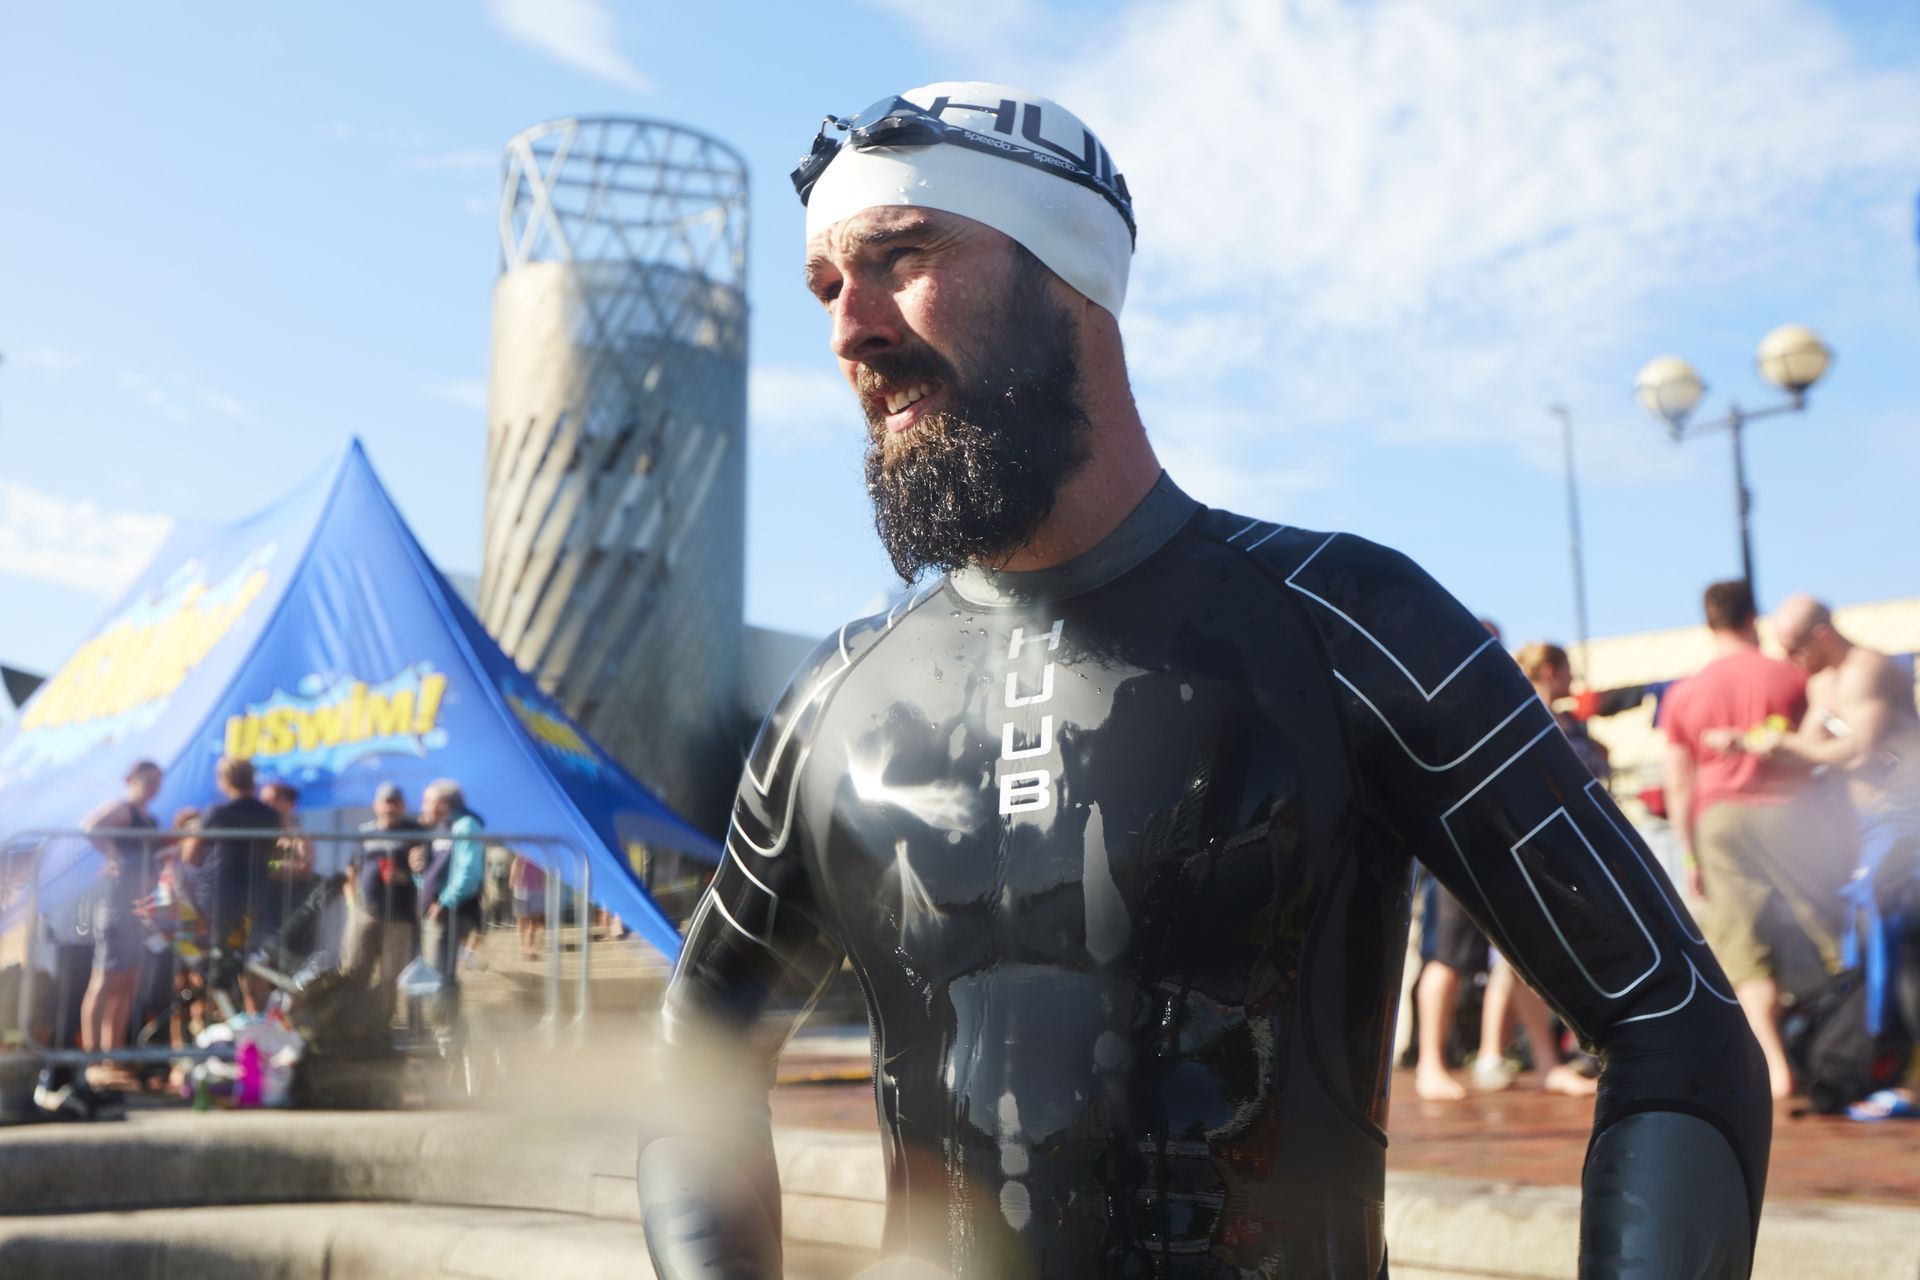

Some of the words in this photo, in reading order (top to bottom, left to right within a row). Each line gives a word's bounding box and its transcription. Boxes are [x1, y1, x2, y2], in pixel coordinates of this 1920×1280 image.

[963, 130, 1011, 151] speedo
[1033, 152, 1075, 171] speedo
[999, 618, 1065, 815] HUUB
